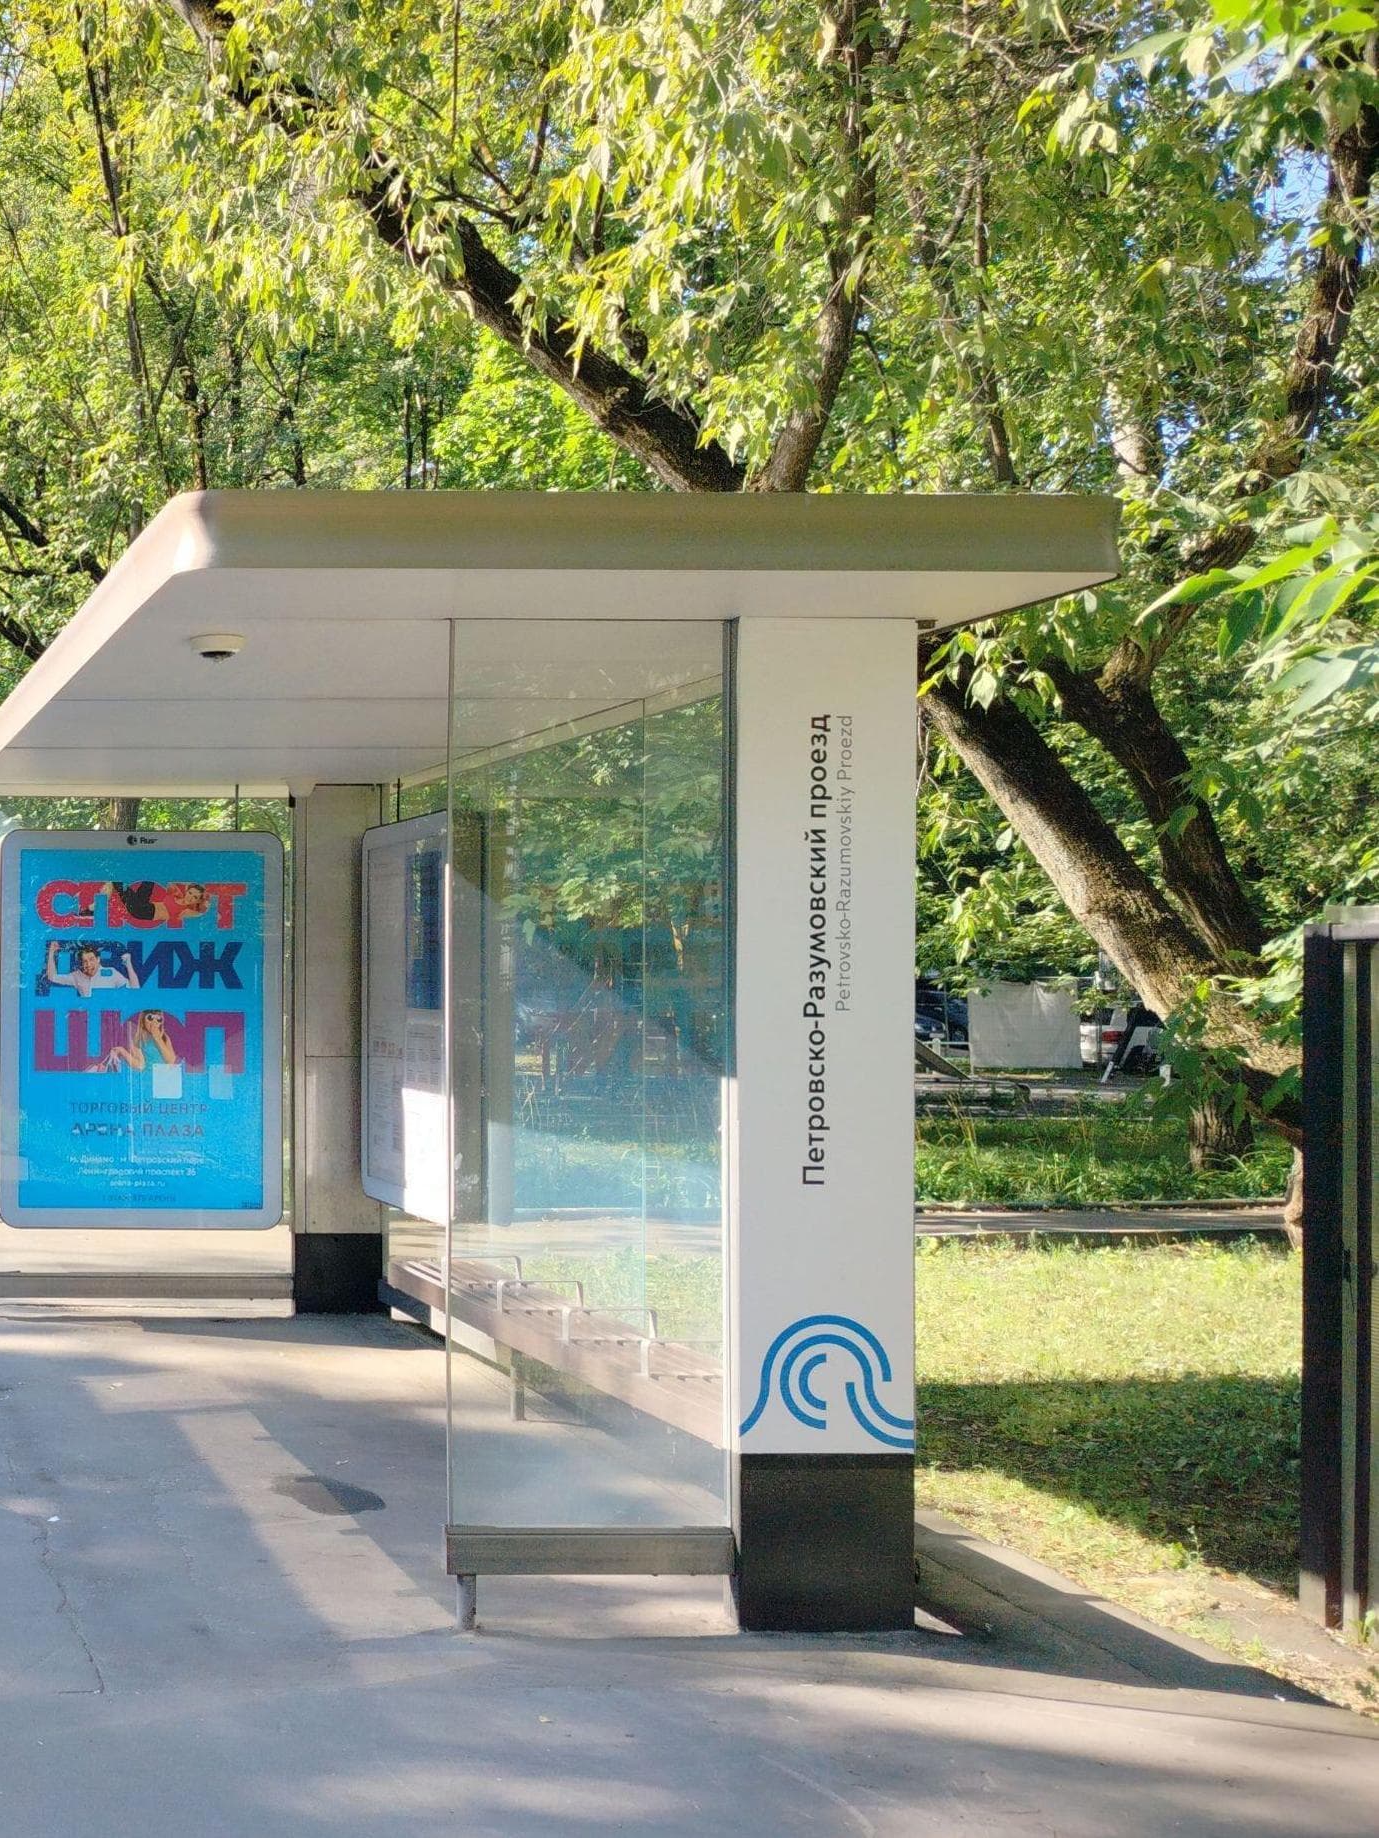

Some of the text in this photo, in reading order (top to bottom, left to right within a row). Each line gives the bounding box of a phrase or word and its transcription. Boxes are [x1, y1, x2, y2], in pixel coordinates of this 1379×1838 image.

[834, 715, 856, 1012] Petrovsko-Razumovskiy Proezd
[36, 879, 247, 930] СПОРТ
[34, 940, 245, 997] ДВИЖ
[802, 713, 833, 1185] Петровско-Разумовский проезд
[33, 1009, 247, 1074] ШОП
[70, 1100, 208, 1115] ТОРГОВЫЙ ЦЕНТР
[142, 1123, 205, 1137] ПЛАЗА
